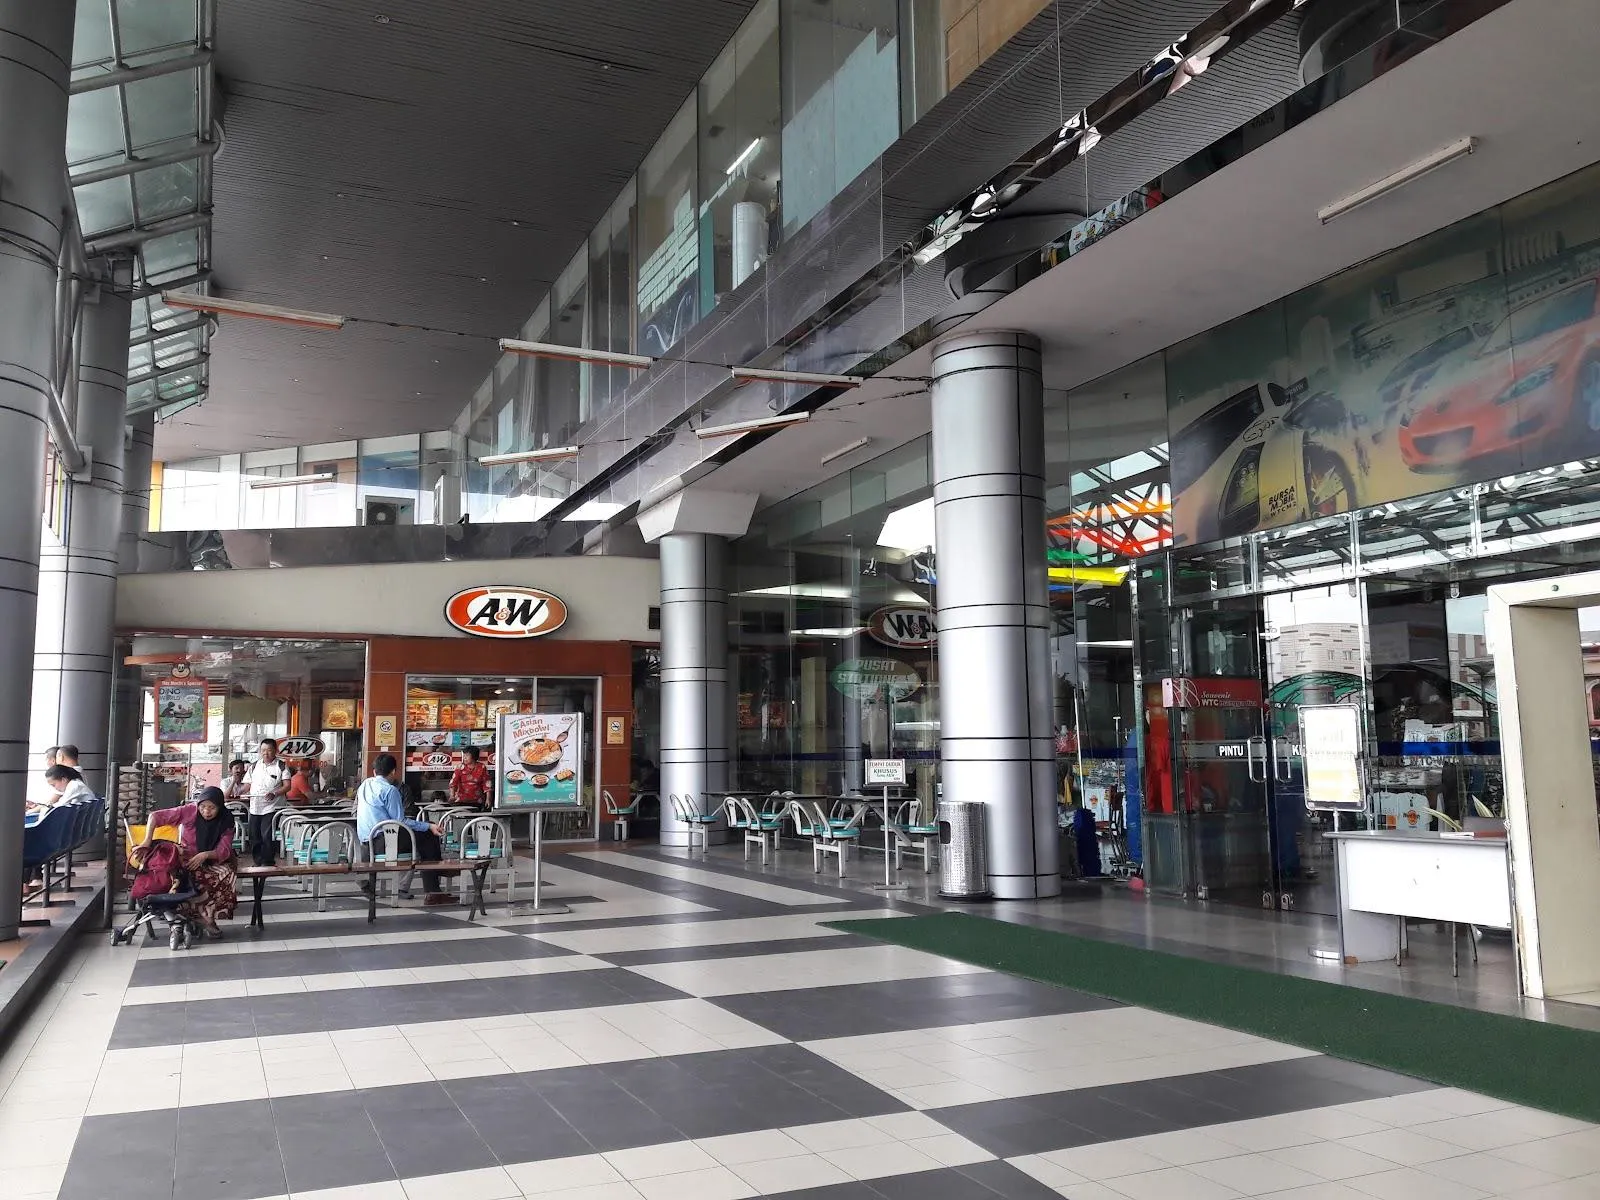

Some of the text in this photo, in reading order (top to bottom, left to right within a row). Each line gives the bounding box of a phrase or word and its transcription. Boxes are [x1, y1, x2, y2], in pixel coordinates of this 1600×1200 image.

[1268, 486, 1295, 505] BURSA
[1270, 492, 1295, 512] MOBIL
[467, 598, 549, 627] A&W
[1201, 699, 1219, 707] WTC
[520, 718, 543, 728] Asian
[512, 724, 550, 739] Mixbowl
[279, 741, 315, 755] A&W
[1219, 745, 1244, 757] PINTU
